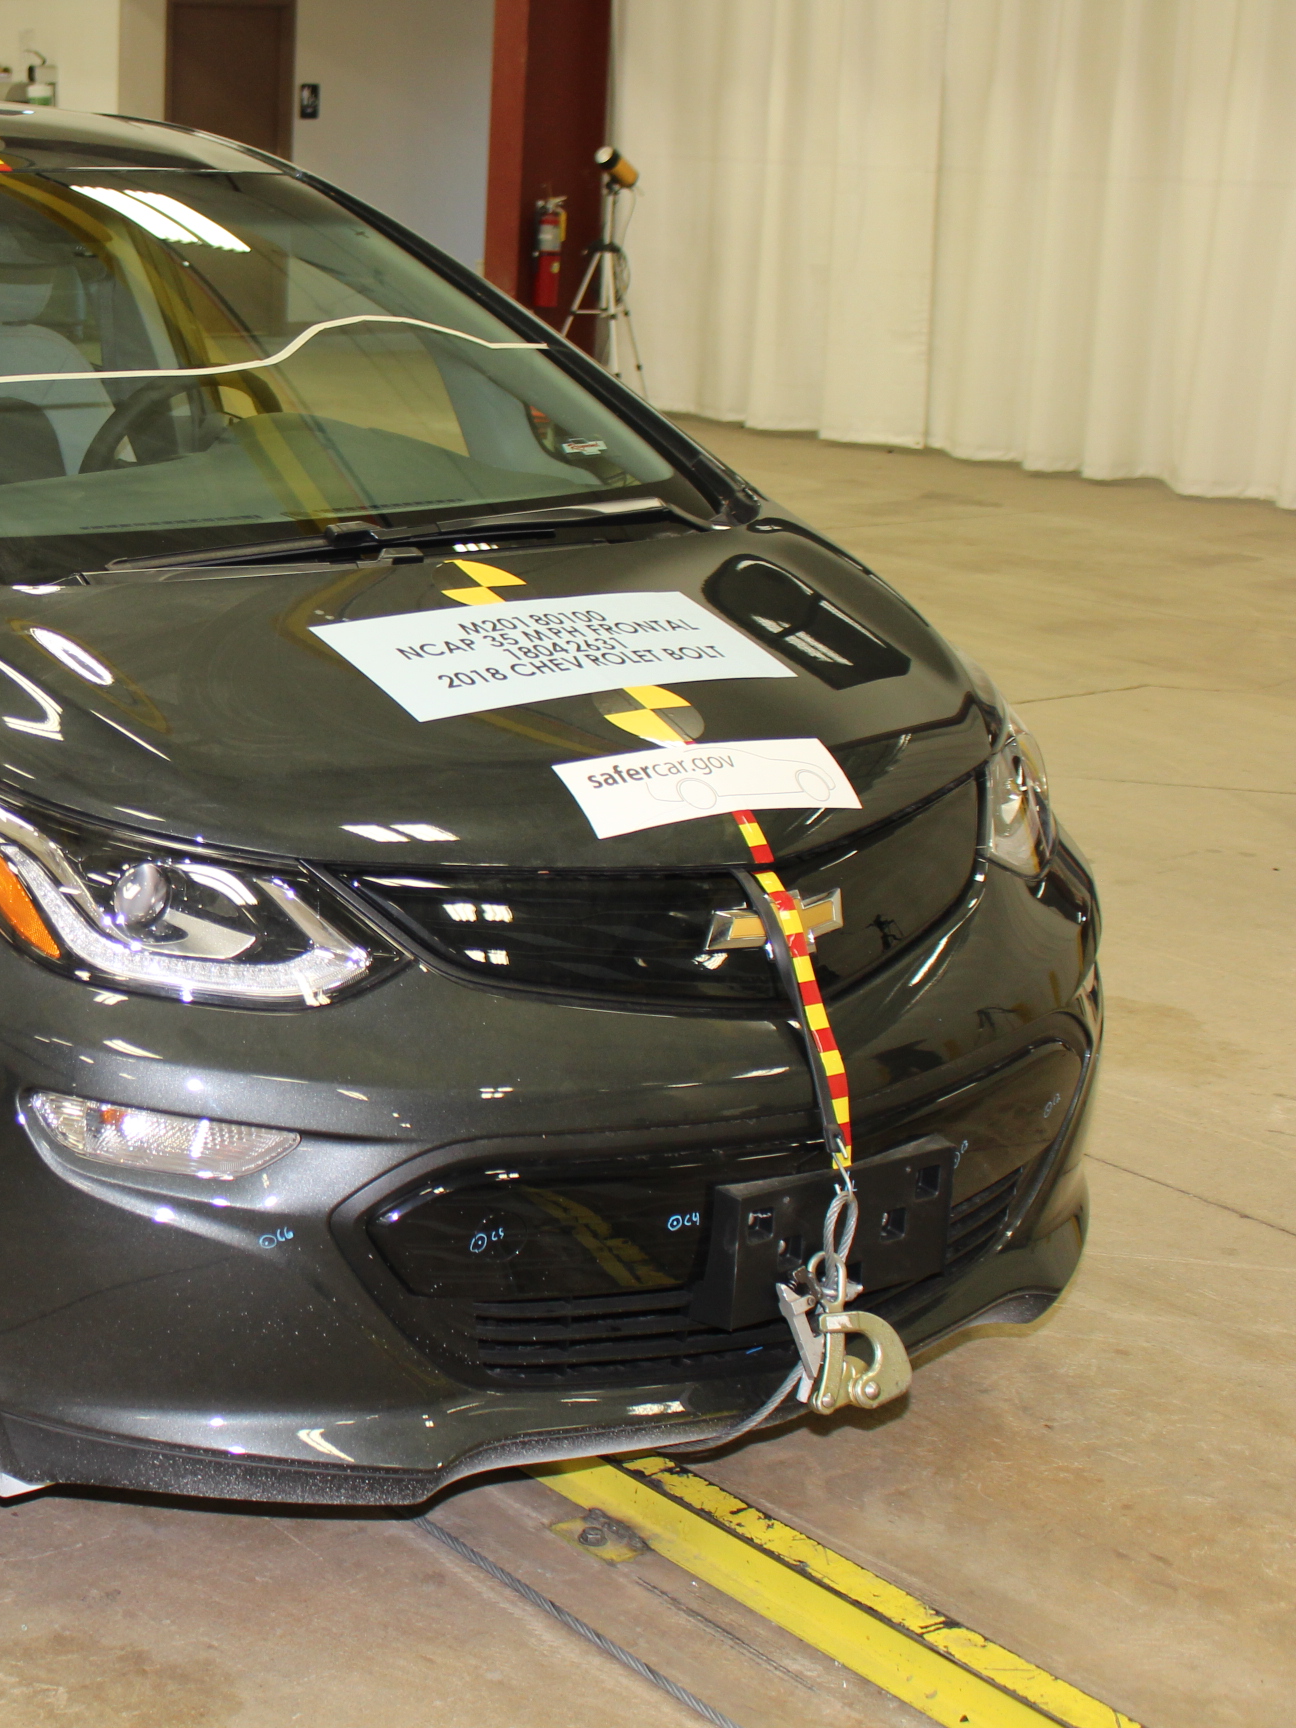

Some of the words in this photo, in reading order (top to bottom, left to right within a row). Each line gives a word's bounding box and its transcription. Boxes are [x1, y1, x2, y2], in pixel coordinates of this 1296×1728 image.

[395, 637, 476, 660] NCAP
[482, 632, 519, 648] 35
[520, 625, 588, 643] MPH
[585, 618, 701, 636] FRONTAL
[457, 610, 607, 635] M20180100
[437, 667, 508, 689] 2018
[510, 649, 663, 677] CHEVROLET
[661, 645, 726, 661] BOLT
[502, 637, 629, 661] 18042631
[587, 753, 736, 789] safercar.gov
